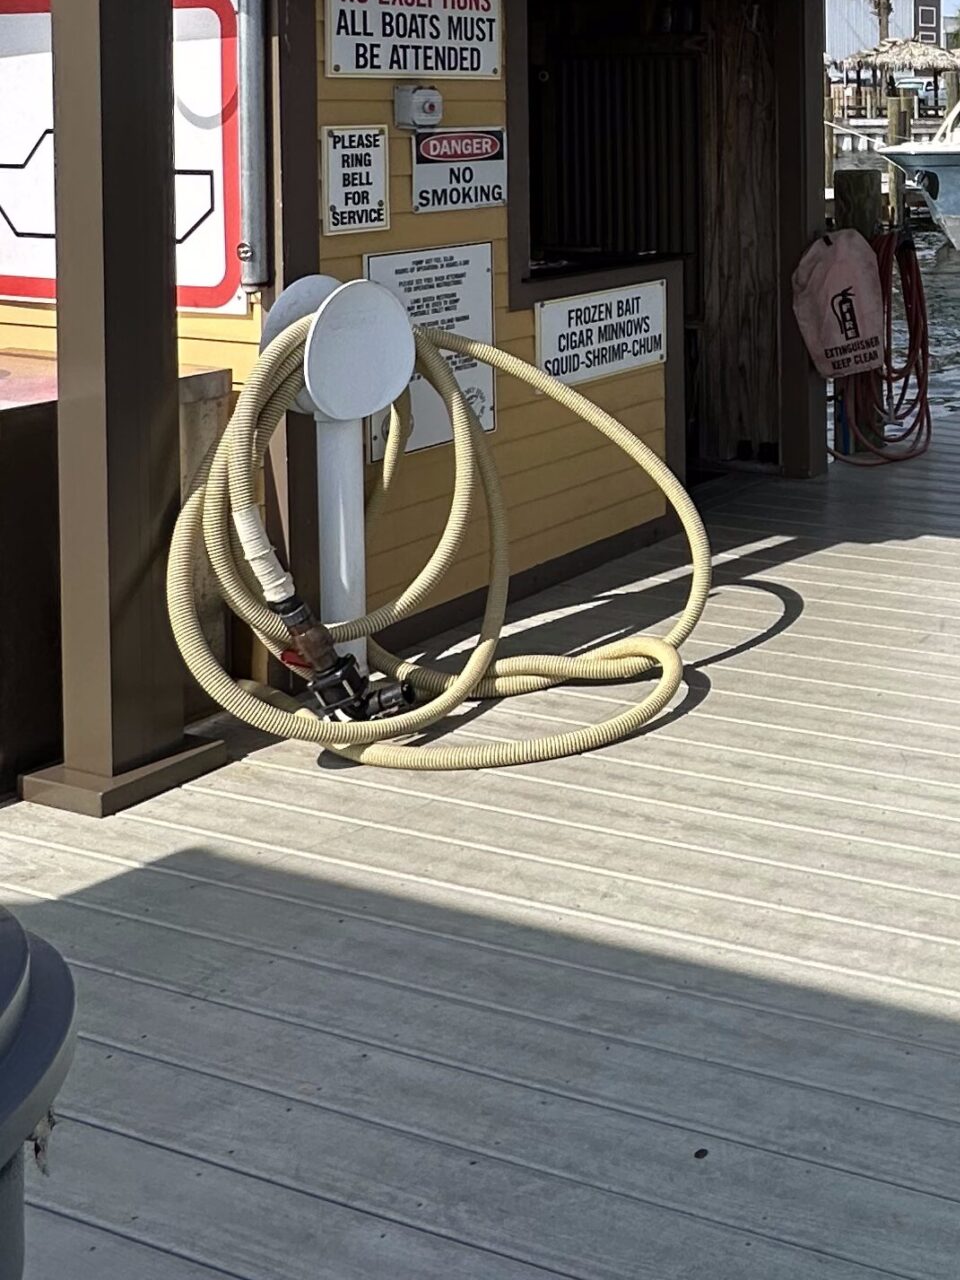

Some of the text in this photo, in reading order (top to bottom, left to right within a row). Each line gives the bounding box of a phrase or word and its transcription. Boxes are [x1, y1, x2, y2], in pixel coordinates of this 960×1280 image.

[336, 9, 496, 42] ALL BOATS MUST
[355, 43, 481, 71] BE ATTENDED
[332, 133, 380, 150] PLEASE
[429, 138, 492, 156] DANGER
[341, 152, 372, 168] RING
[342, 172, 373, 187] BELL
[450, 166, 474, 185] NO
[344, 191, 370, 206] FOR
[418, 184, 503, 207] SMOKING
[332, 208, 384, 226] SERVICE
[568, 296, 641, 328] FROZEN BAIT
[841, 302, 857, 338] FIRE
[558, 316, 650, 353] CIGAR MINNOWS
[544, 334, 662, 377] SQUID-SHRIMP-CHUM
[824, 335, 880, 359] EXTINGUISHER
[831, 350, 879, 370] KEEP CLEAR
